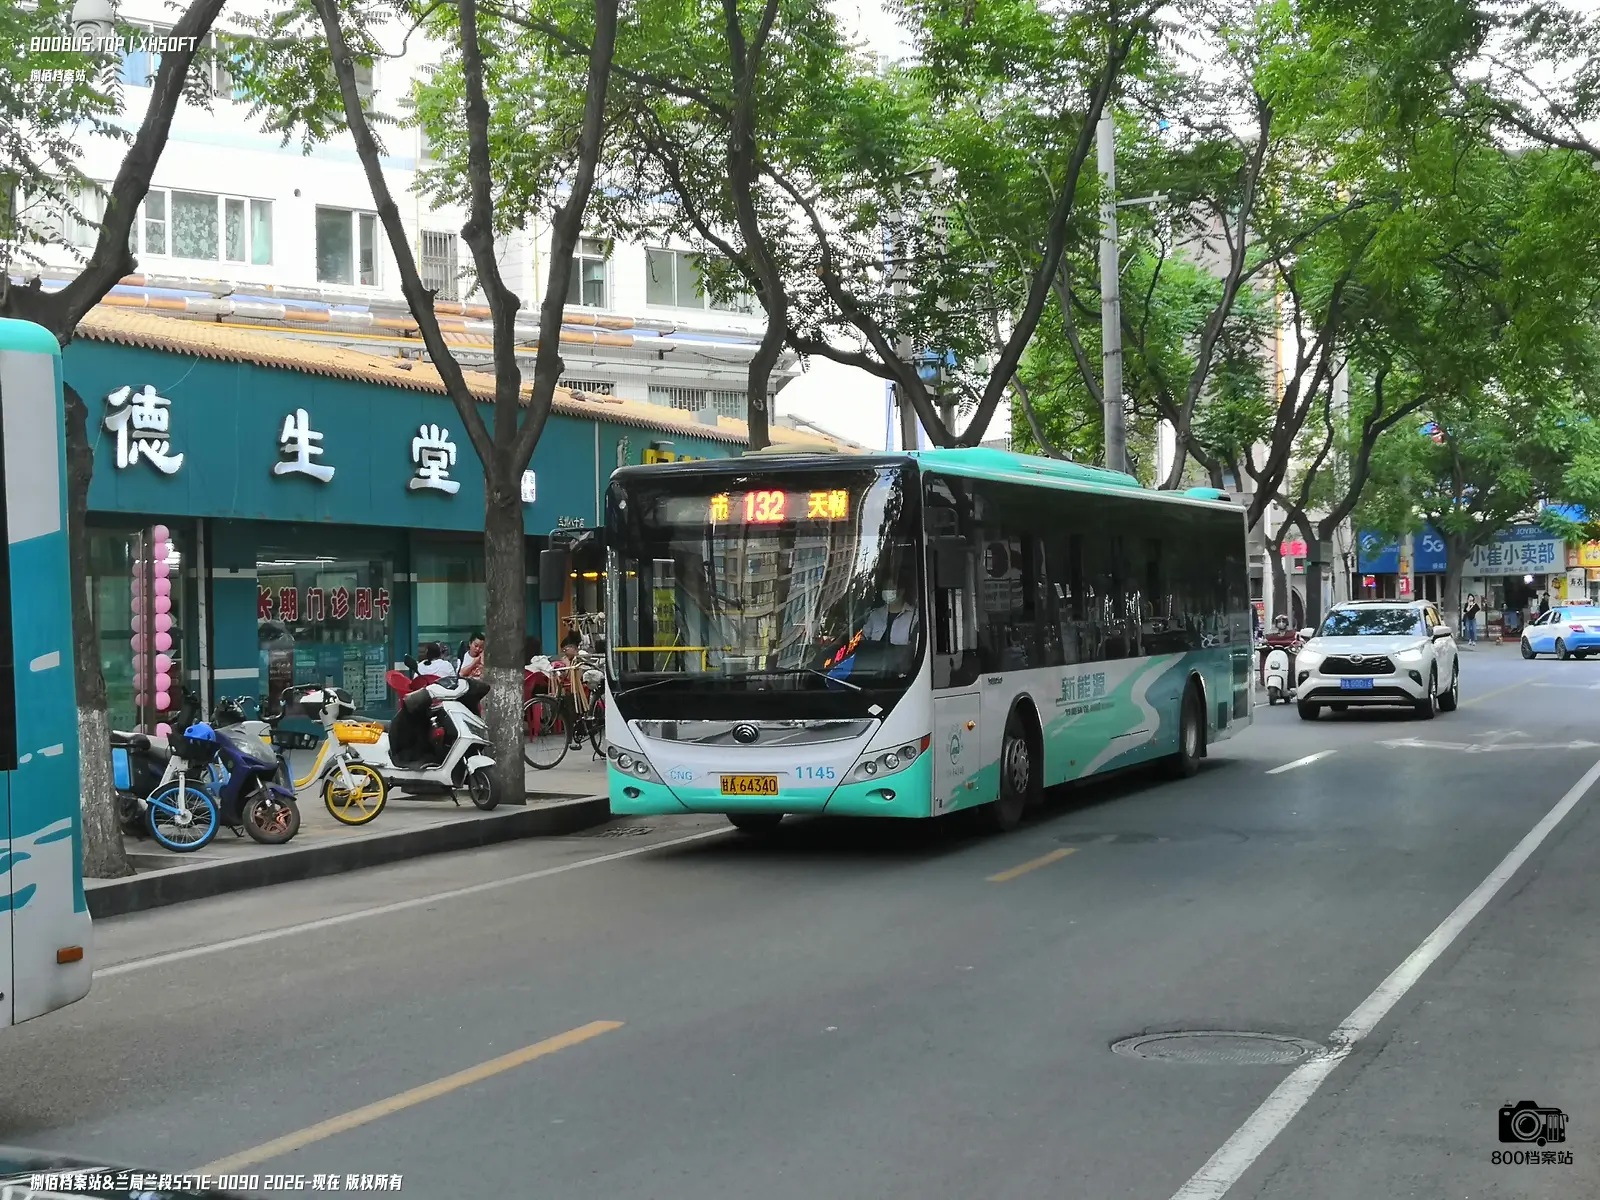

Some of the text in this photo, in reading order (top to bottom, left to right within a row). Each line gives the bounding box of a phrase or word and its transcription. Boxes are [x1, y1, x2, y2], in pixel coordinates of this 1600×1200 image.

[105, 384, 461, 492] 德生堂
[744, 491, 785, 521] 132
[1422, 534, 1444, 552] 5G
[1470, 542, 1555, 567] 小崔小卖部
[257, 585, 390, 621] 长期门诊刷卡
[670, 770, 693, 781] CNG
[795, 766, 835, 780] 1145
